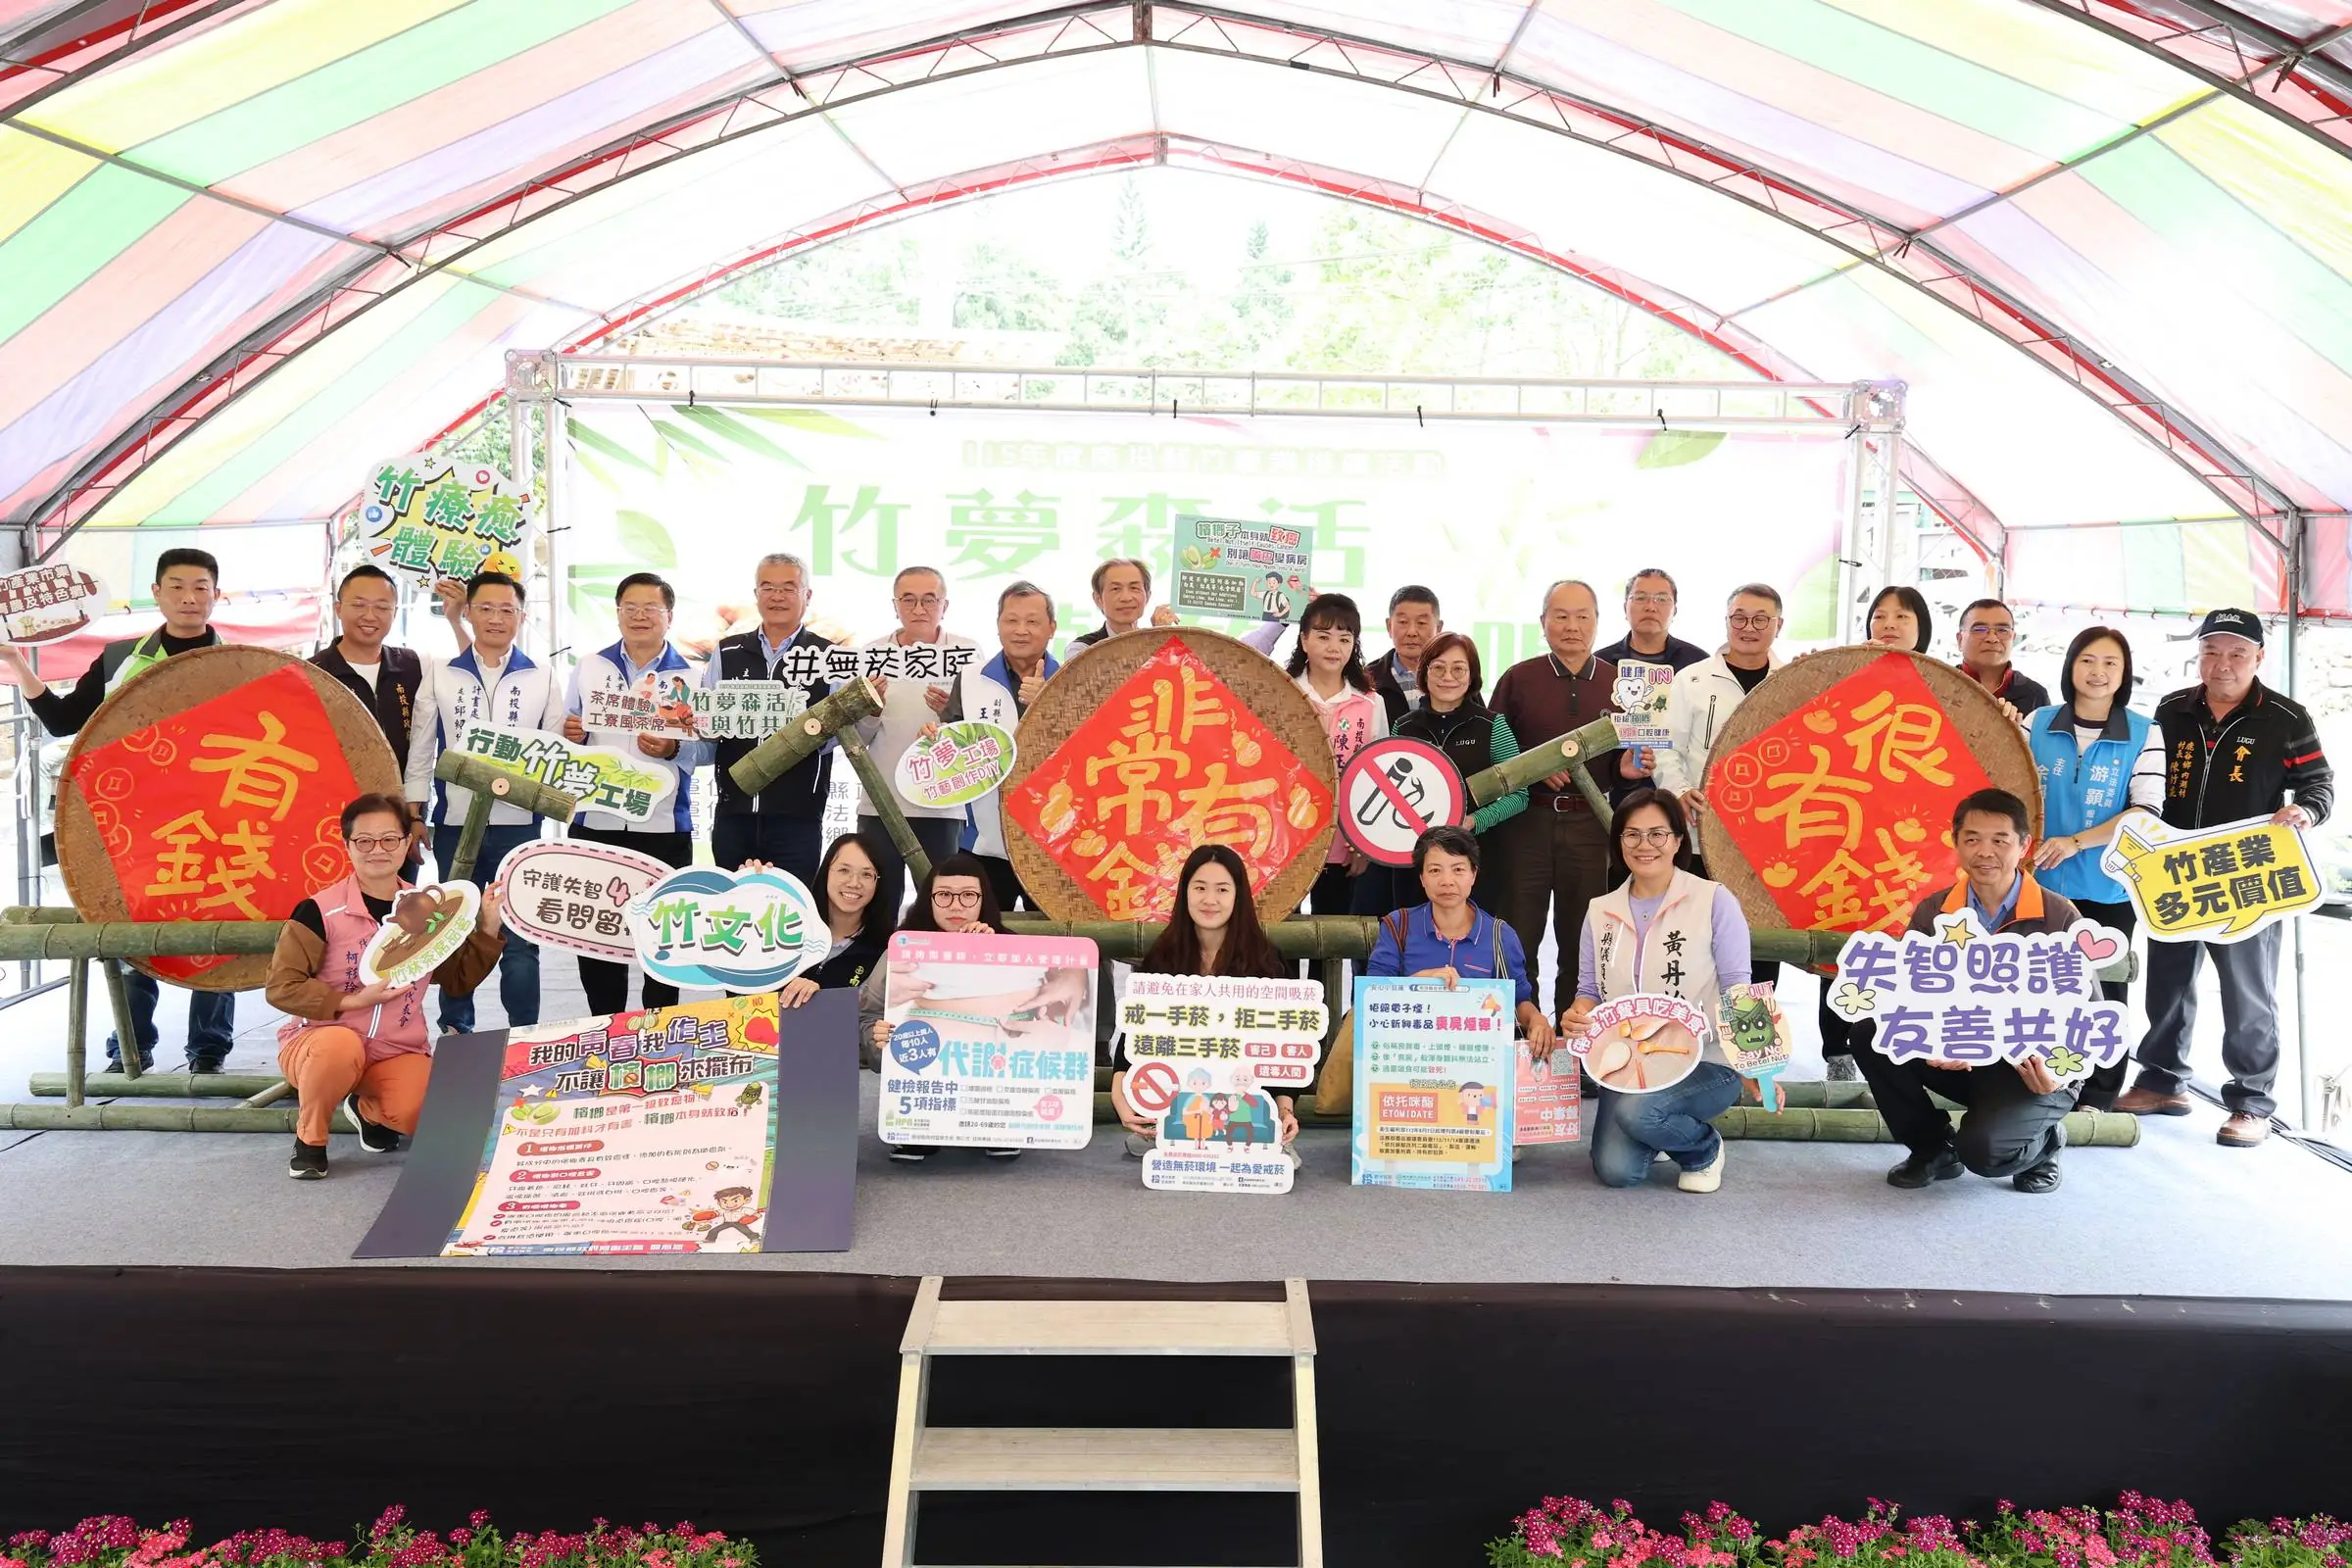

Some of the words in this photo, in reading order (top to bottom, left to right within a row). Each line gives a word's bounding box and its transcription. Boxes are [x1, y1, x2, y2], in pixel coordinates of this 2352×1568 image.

[376, 465, 524, 541] 竹療癒
[392, 525, 483, 580] 體驗
[788, 646, 976, 682] #無菸家庭
[1621, 666, 1645, 678] 健康
[1648, 668, 1673, 685] IN
[507, 685, 521, 727] 南投縣
[590, 690, 652, 713] 茶席體驗
[692, 691, 786, 712] 竹夢森活
[2236, 736, 2256, 745] LUGU
[466, 726, 653, 817] 行動竹夢工場
[907, 736, 1001, 782] 竹夢工場
[2228, 745, 2252, 783] 會長
[2163, 833, 2277, 886] 竹產業
[2154, 865, 2308, 926] 多元價值
[535, 897, 631, 937] 看問留
[651, 898, 806, 956] 竹文化
[1661, 930, 1687, 1001] 黃丹
[1843, 940, 2084, 997] 失智照護
[753, 997, 763, 1007] NO
[1132, 981, 1317, 1002] 請避免在家人共用的空間吸菸
[1747, 981, 1774, 999] OUT
[1125, 1004, 1321, 1032] 戒一手菸，拒二手菸
[1878, 1004, 2123, 1062] 友善共好
[529, 1016, 730, 1066] 我的青春我作主
[1134, 1035, 1241, 1059] 遠離三手菸
[1738, 1050, 1762, 1061] Say
[1765, 1045, 1783, 1056] No
[556, 1054, 755, 1095] 不讓檳榔來擺布
[938, 1040, 1090, 1082] 代謝症候群
[1747, 1057, 1770, 1068] Betel
[887, 1079, 959, 1096] 健檢報告中
[898, 1095, 957, 1116] 5項指標
[1382, 1096, 1435, 1108] 依托咪酯
[1381, 1108, 1435, 1119] ETOMIDATE
[1151, 1159, 1217, 1174] 營造無菸環境
[1218, 1161, 1286, 1176] 一起為愛戒菸
